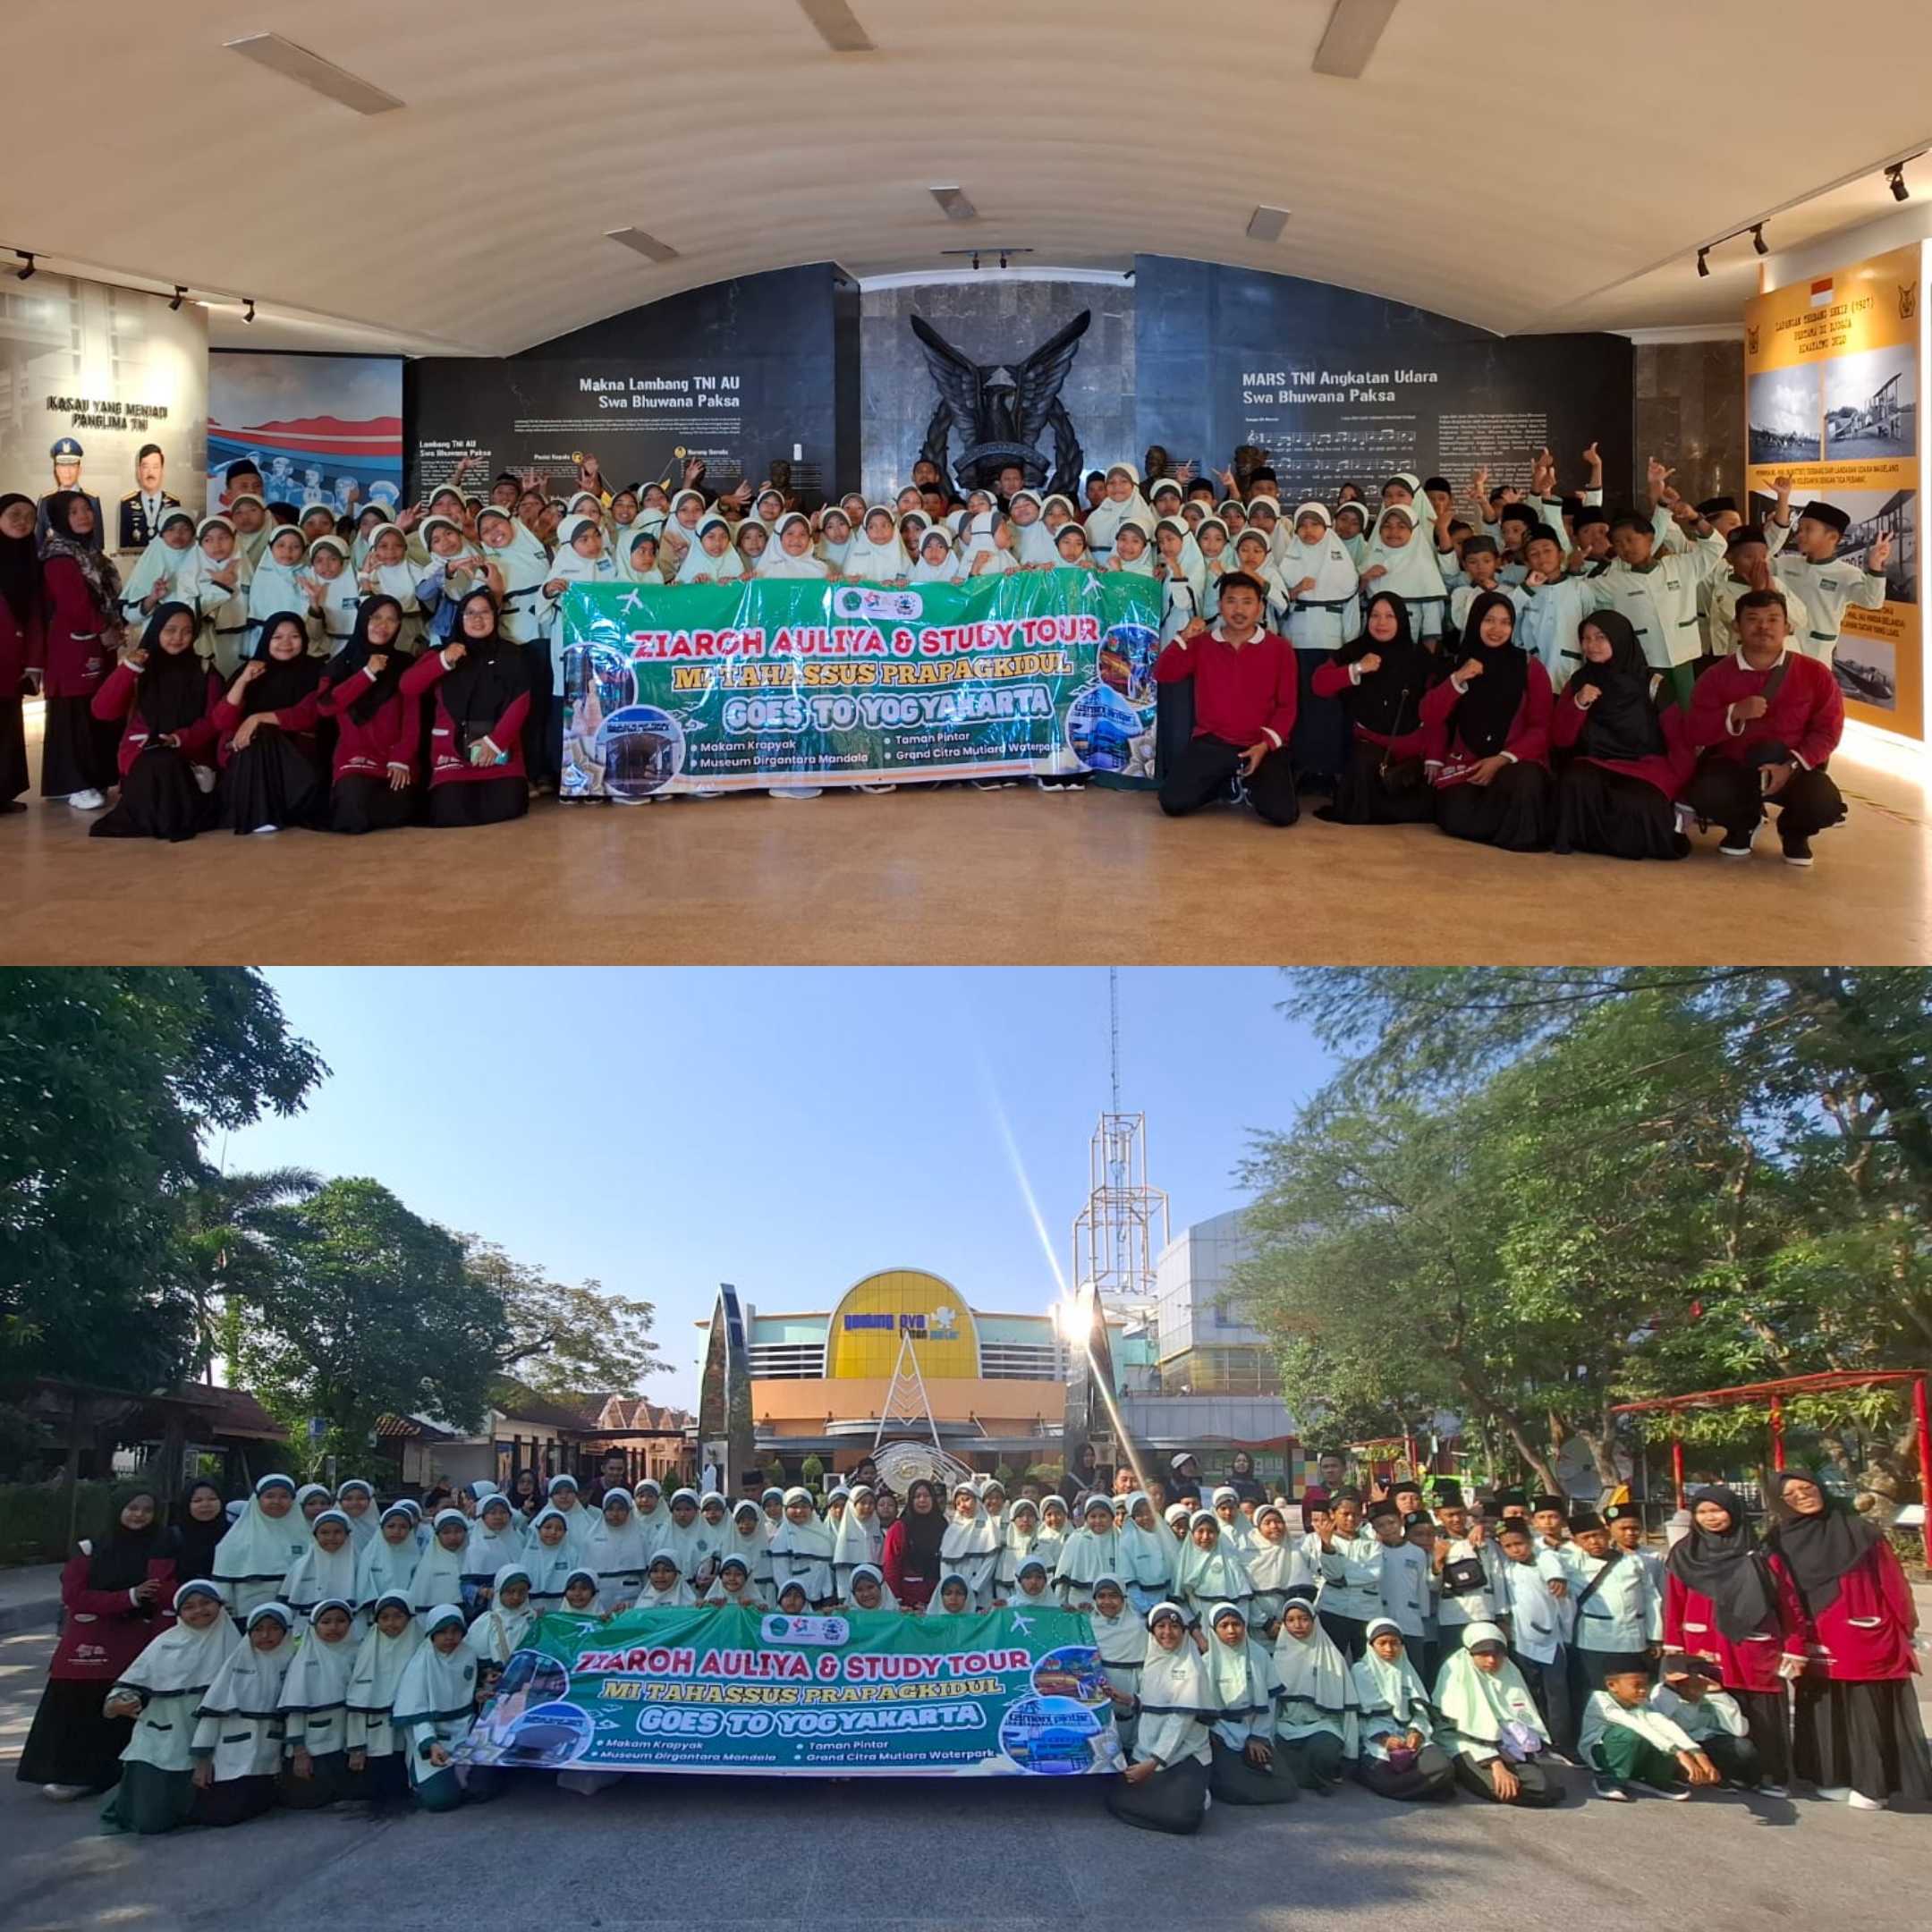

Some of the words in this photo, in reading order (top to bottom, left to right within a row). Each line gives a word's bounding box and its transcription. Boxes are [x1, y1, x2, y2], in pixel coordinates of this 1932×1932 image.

[580, 378, 624, 391] Makna
[630, 377, 689, 393] Lambang
[693, 377, 716, 389] TNI
[721, 376, 740, 389] AU
[1242, 372, 1285, 386] MARS
[1292, 372, 1315, 385] TNI
[1320, 371, 1389, 386] Angkatan
[1394, 369, 1438, 384] Udara
[598, 395, 627, 408] Swa
[632, 394, 693, 408] Bhuwana
[698, 394, 740, 407] Paksa
[1242, 391, 1274, 403] Swa
[1279, 390, 1344, 402] Bhuwana
[1350, 388, 1395, 402] Paksa
[47, 395, 89, 412] KASAU
[92, 401, 122, 415] YANG
[72, 413, 127, 430] PANGLIMA
[131, 418, 148, 432] TNI
[633, 630, 762, 658] ZIAROH
[773, 629, 885, 654] AULIYA
[894, 630, 912, 654] &
[922, 623, 1013, 653] STUDY
[1022, 618, 1098, 644] TOUR
[719, 663, 877, 689] TAHASSUS
[883, 653, 1072, 685] PRAPAGKIDUL
[726, 699, 804, 727] GOES
[812, 699, 852, 724] TO
[860, 688, 1050, 723] YOGYAKARTA
[896, 734, 936, 744] Taman
[937, 732, 970, 742] Pintar
[700, 742, 745, 753] Makam
[748, 740, 796, 754] Krapyak
[896, 749, 931, 760] Grand
[933, 746, 960, 758] Citra
[962, 744, 1005, 756] Mutiara
[700, 758, 750, 768] Museum
[753, 754, 816, 767] Dirgantara
[818, 753, 869, 764] Mandala
[575, 1649, 694, 1673] ZIAROH
[700, 1652, 809, 1677] AULIYA
[819, 1656, 837, 1678] &
[847, 1655, 942, 1679] STUDY
[948, 1651, 1029, 1674] TOUR
[602, 1681, 640, 1699] MI
[647, 1682, 800, 1704] TAHASSUS
[804, 1678, 1003, 1704] PRAPAGKIDUL
[640, 1708, 720, 1733] GOES
[728, 1713, 769, 1734] TO
[779, 1705, 979, 1733] YOGYAKARTA
[606, 1739, 651, 1749] Makam
[653, 1740, 703, 1750] Krapyak
[809, 1741, 851, 1750] Taman
[853, 1740, 888, 1750] Pintar
[600, 1750, 652, 1759] Museum
[654, 1751, 720, 1762] Dirgantara
[723, 1752, 776, 1762] Mandala
[807, 1752, 843, 1761] Grand
[847, 1751, 877, 1761] Citra
[879, 1750, 927, 1760] Mutiara
[929, 1748, 996, 1761] Waterpark
